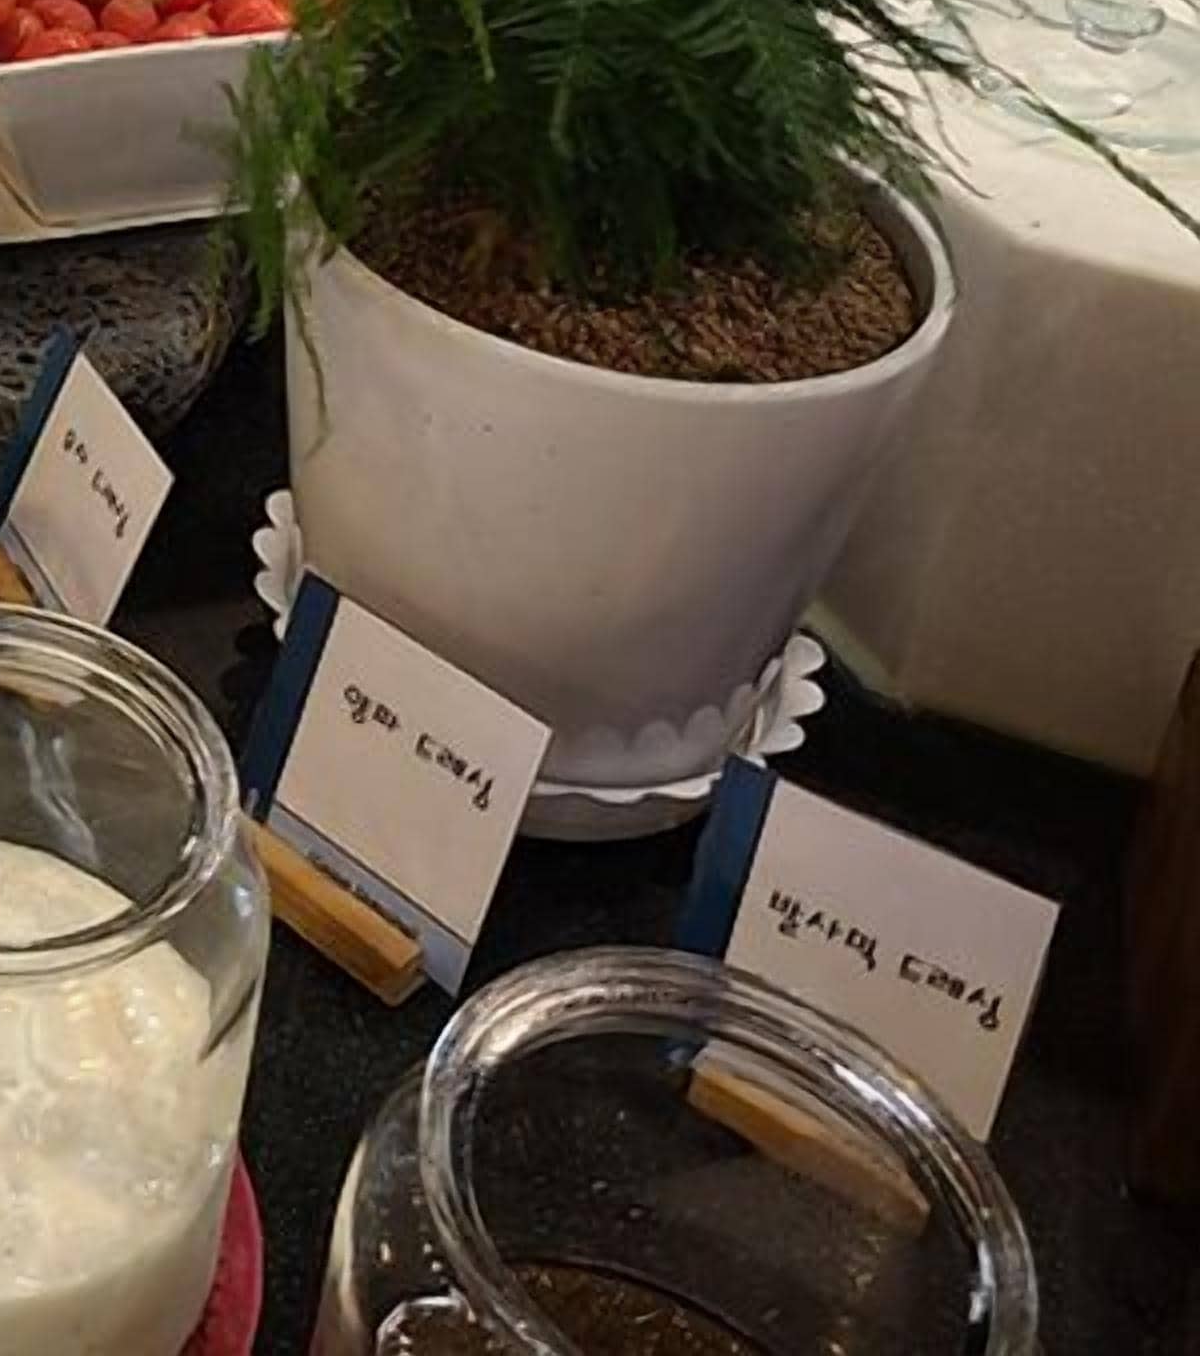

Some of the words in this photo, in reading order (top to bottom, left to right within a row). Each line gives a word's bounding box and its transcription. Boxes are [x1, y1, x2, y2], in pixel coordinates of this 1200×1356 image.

[342, 682, 400, 732] 양파
[415, 732, 495, 813] 드레싱
[767, 889, 878, 973] 발사믹
[899, 952, 1002, 1032] 드레싱
